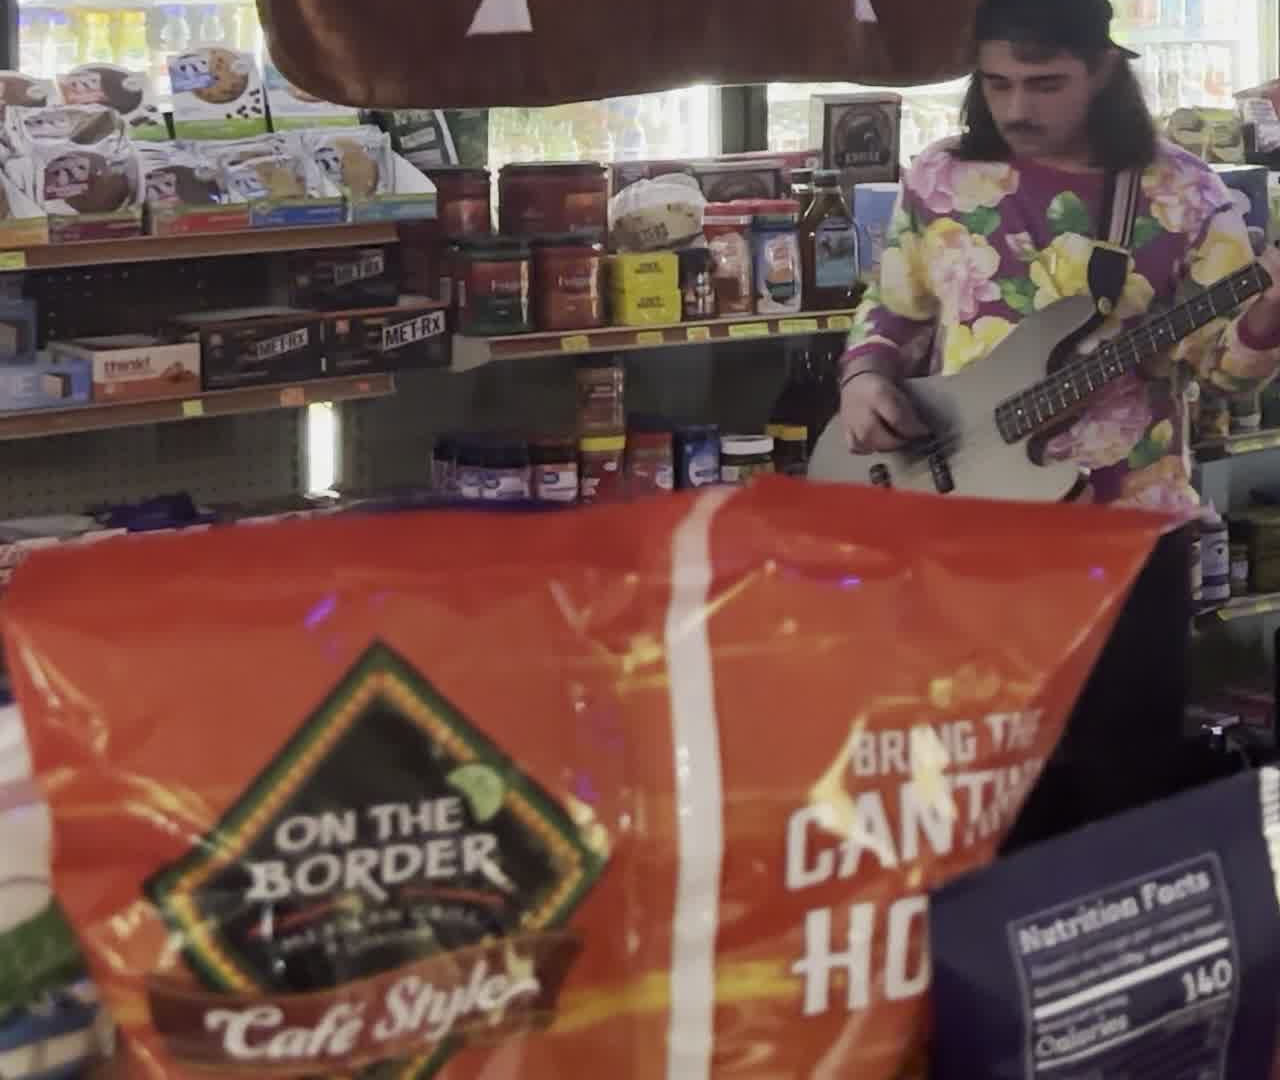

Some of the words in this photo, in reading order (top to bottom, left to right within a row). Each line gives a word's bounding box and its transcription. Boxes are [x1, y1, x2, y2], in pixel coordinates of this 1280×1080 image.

[274, 810, 356, 852] ON
[369, 796, 464, 840] THE
[244, 833, 516, 902] BORDER
[1019, 896, 1139, 954] Nutrition
[1139, 871, 1210, 912] Facts
